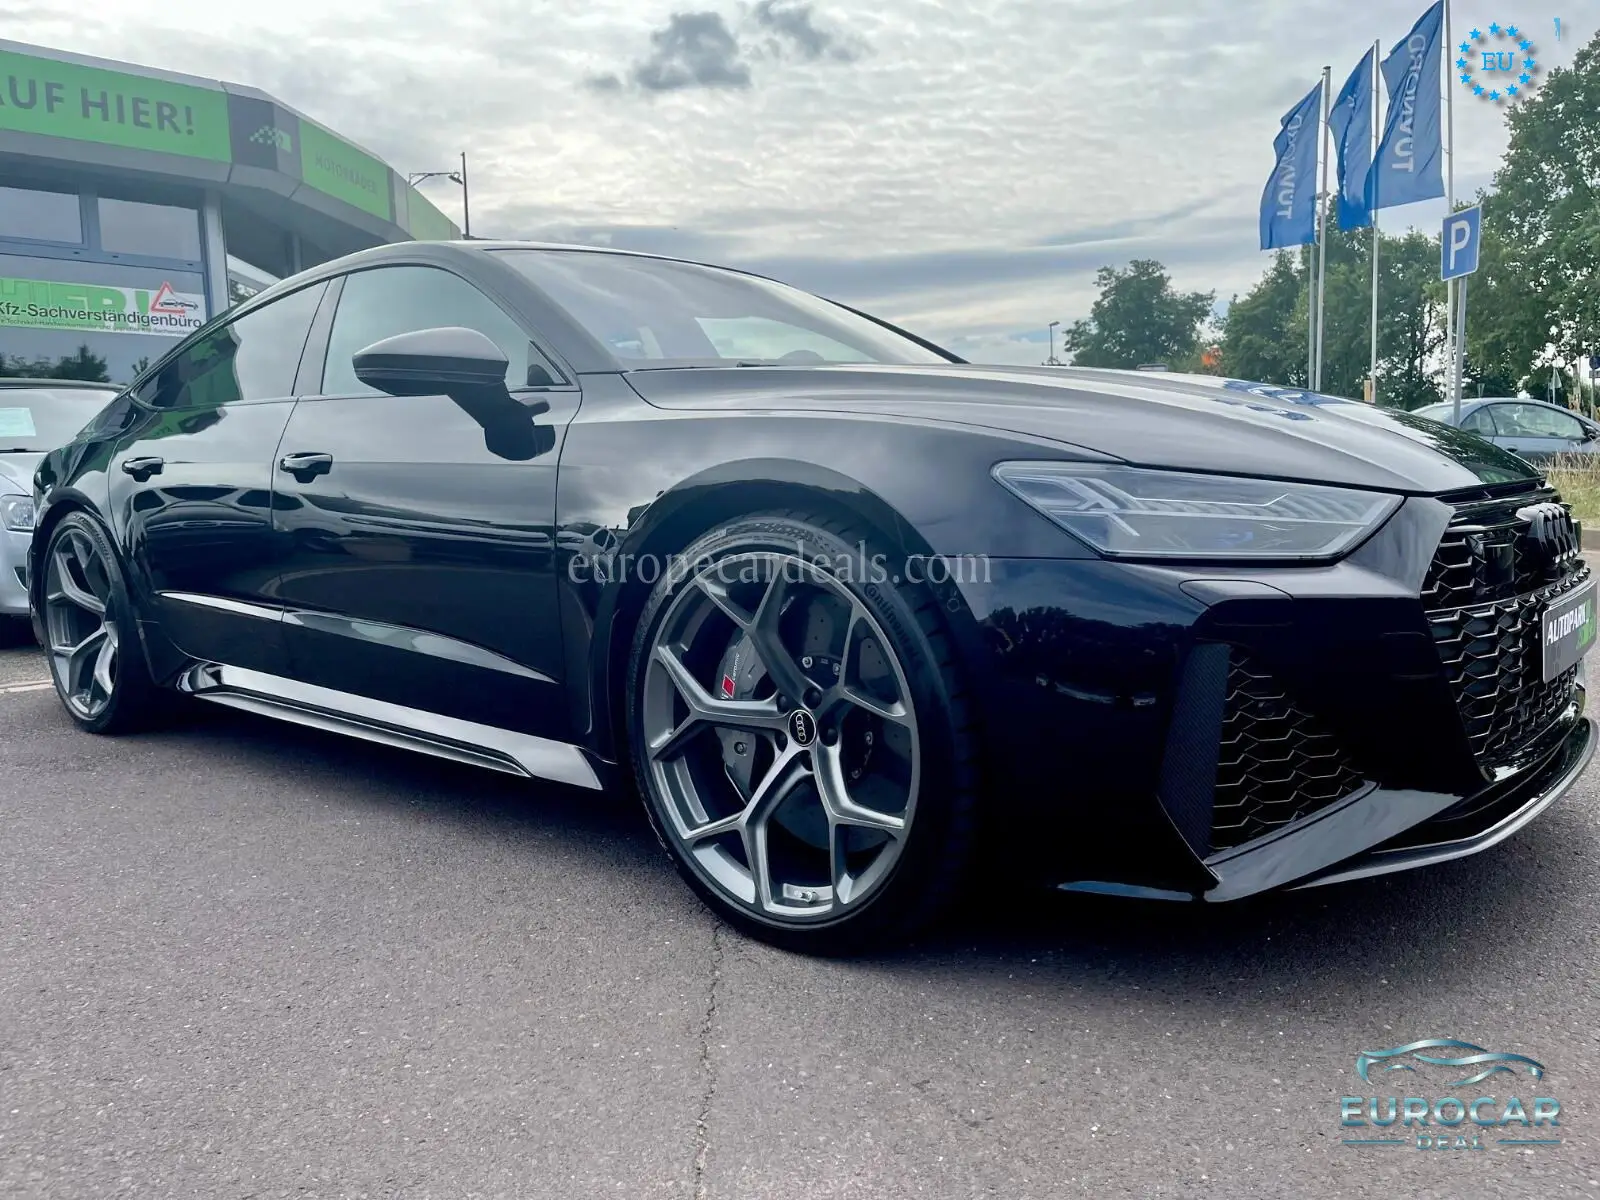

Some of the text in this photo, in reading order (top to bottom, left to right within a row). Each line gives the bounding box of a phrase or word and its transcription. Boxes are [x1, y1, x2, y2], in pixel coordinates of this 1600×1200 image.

[0, 75, 195, 136] UF HIER!
[1449, 219, 1471, 270] P
